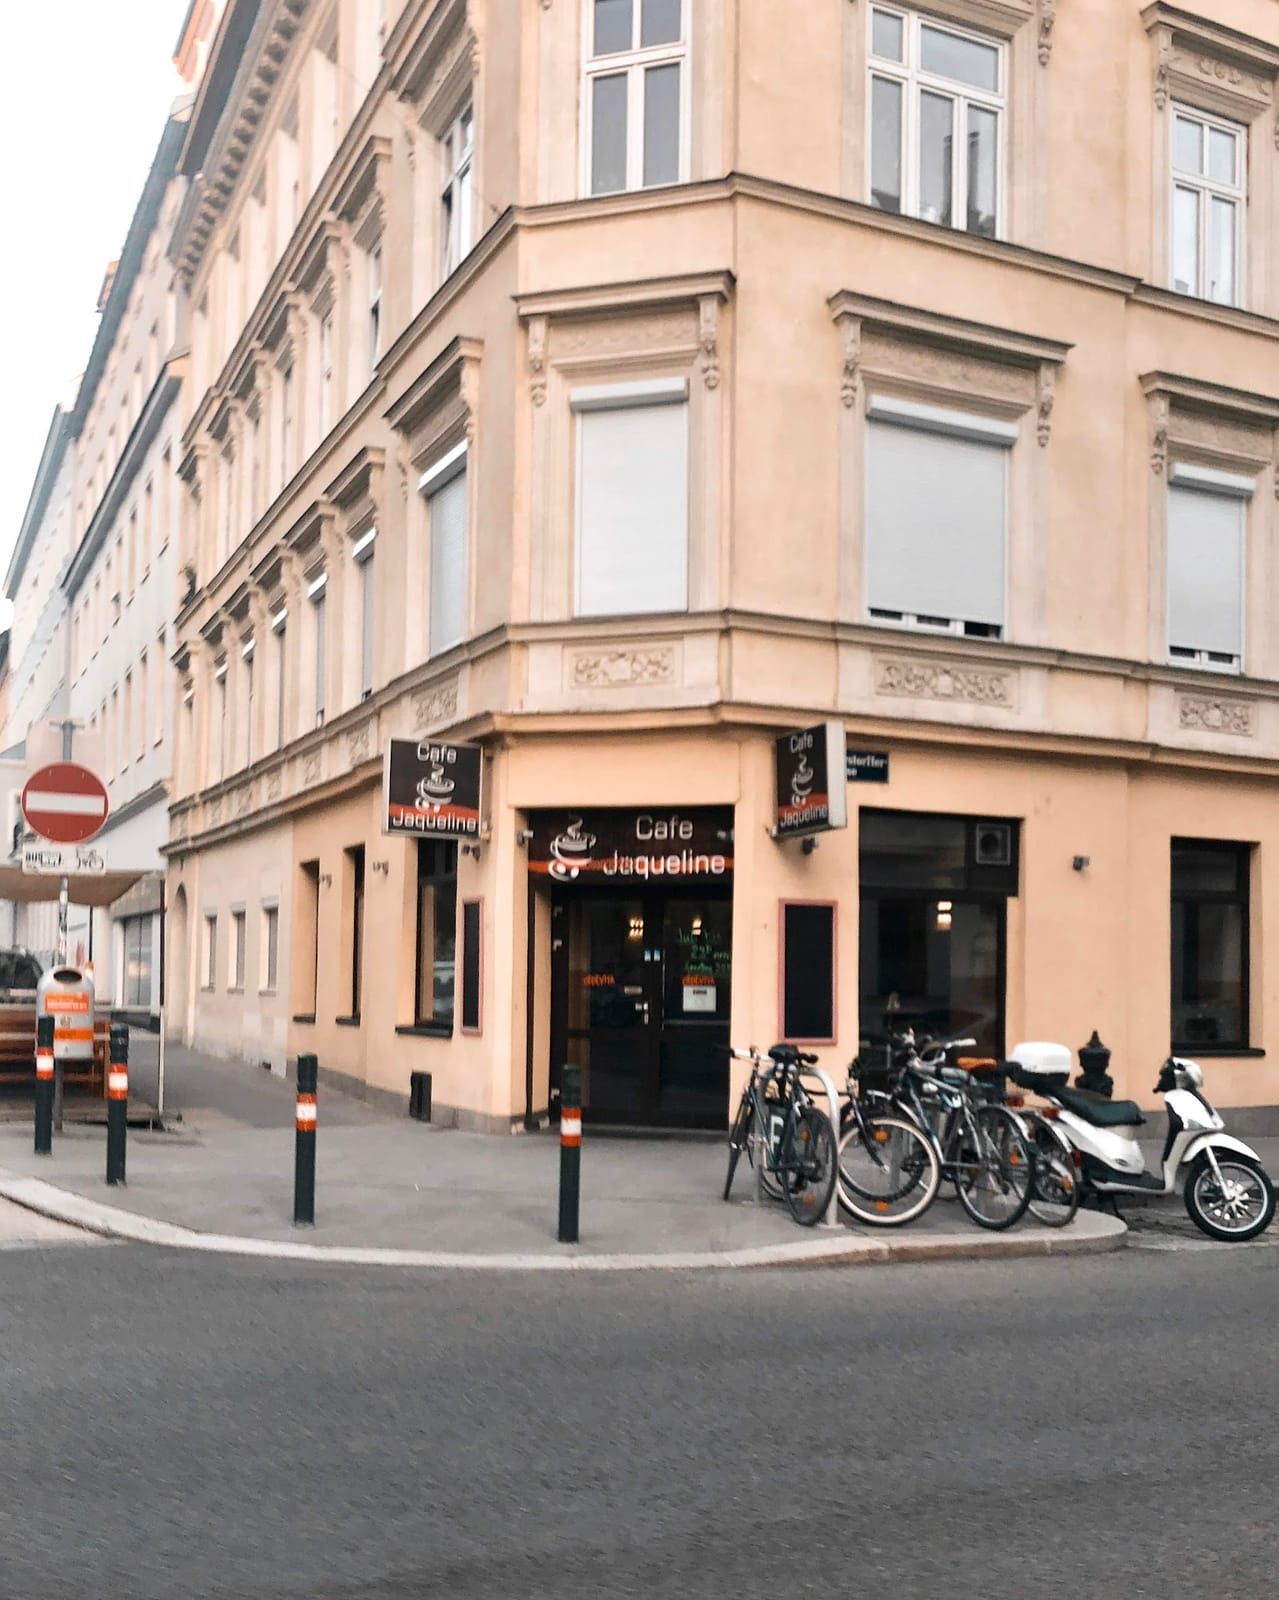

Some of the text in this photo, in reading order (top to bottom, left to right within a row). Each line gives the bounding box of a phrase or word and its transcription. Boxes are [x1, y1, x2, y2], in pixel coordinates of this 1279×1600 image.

[417, 742, 457, 764] Cafe
[790, 732, 813, 753] Cafe
[393, 808, 476, 832] Jaqueline
[636, 815, 693, 840] Cafe
[780, 803, 828, 828] Jaqueline
[603, 849, 725, 880] Jaqueline
